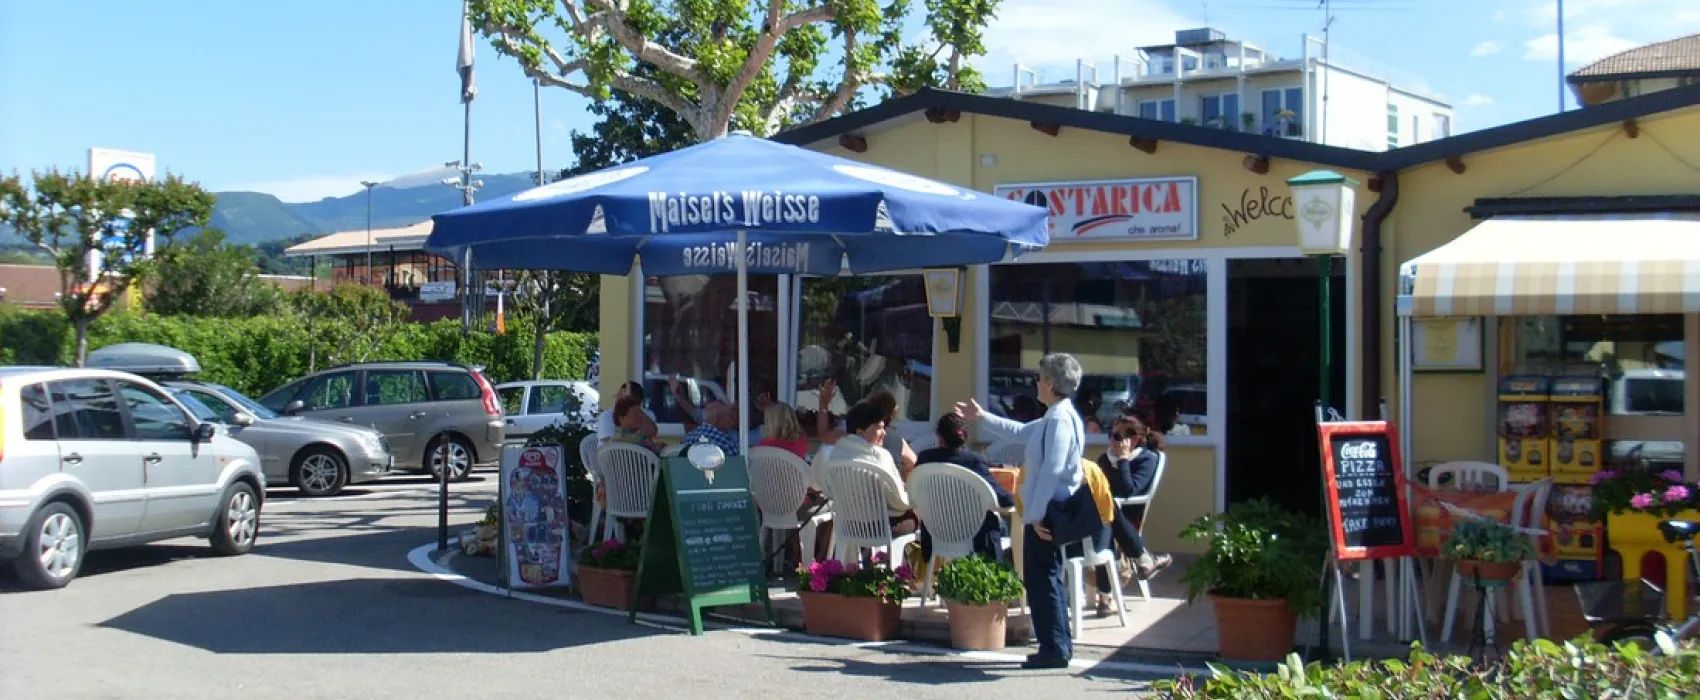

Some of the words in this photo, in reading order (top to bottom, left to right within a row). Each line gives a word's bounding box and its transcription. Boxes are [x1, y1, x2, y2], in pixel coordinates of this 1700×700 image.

[648, 191, 735, 233] Maisel's
[741, 190, 820, 226] Weisse
[1340, 460, 1384, 473] PIZZA
